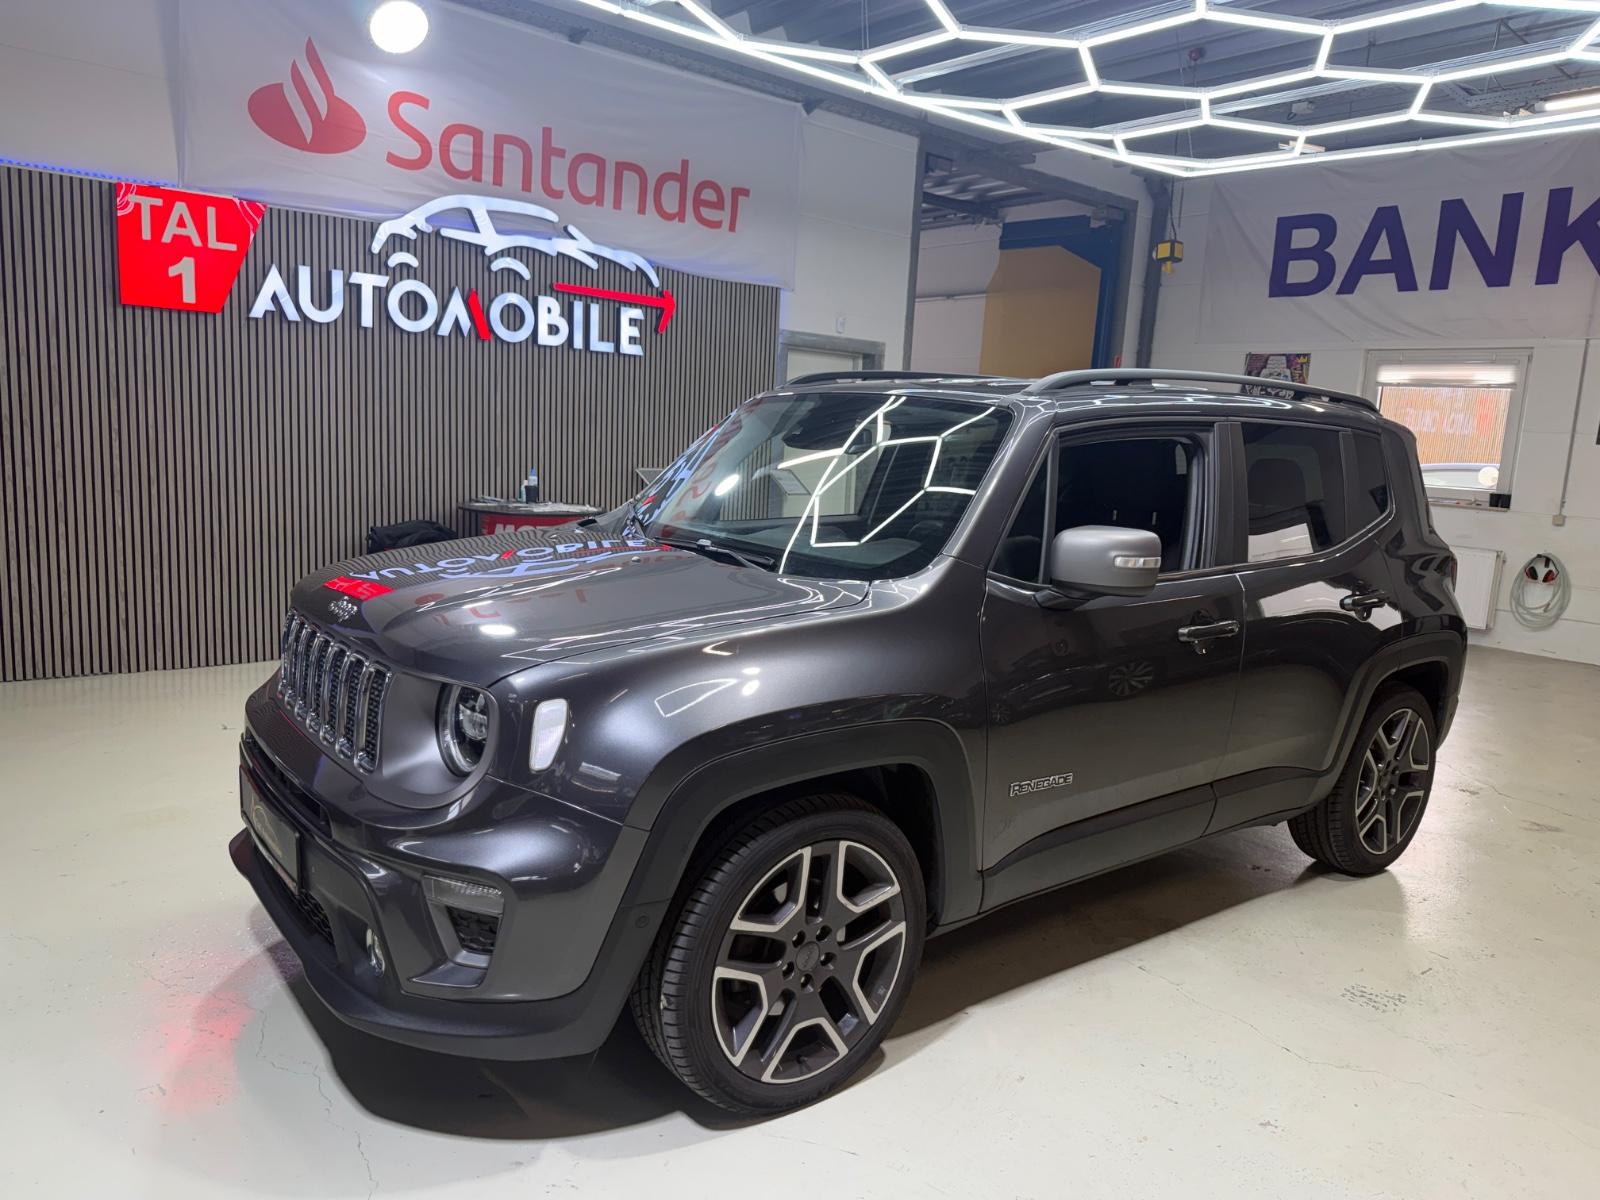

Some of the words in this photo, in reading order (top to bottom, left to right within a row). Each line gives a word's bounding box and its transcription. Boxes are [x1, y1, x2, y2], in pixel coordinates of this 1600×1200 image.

[385, 91, 750, 233] Santander
[127, 194, 238, 251] TAL
[1268, 186, 1600, 298] BANK
[168, 256, 196, 304] 1
[248, 263, 645, 356] AUTOMOBILE
[1009, 772, 1073, 797] RENEGADE
